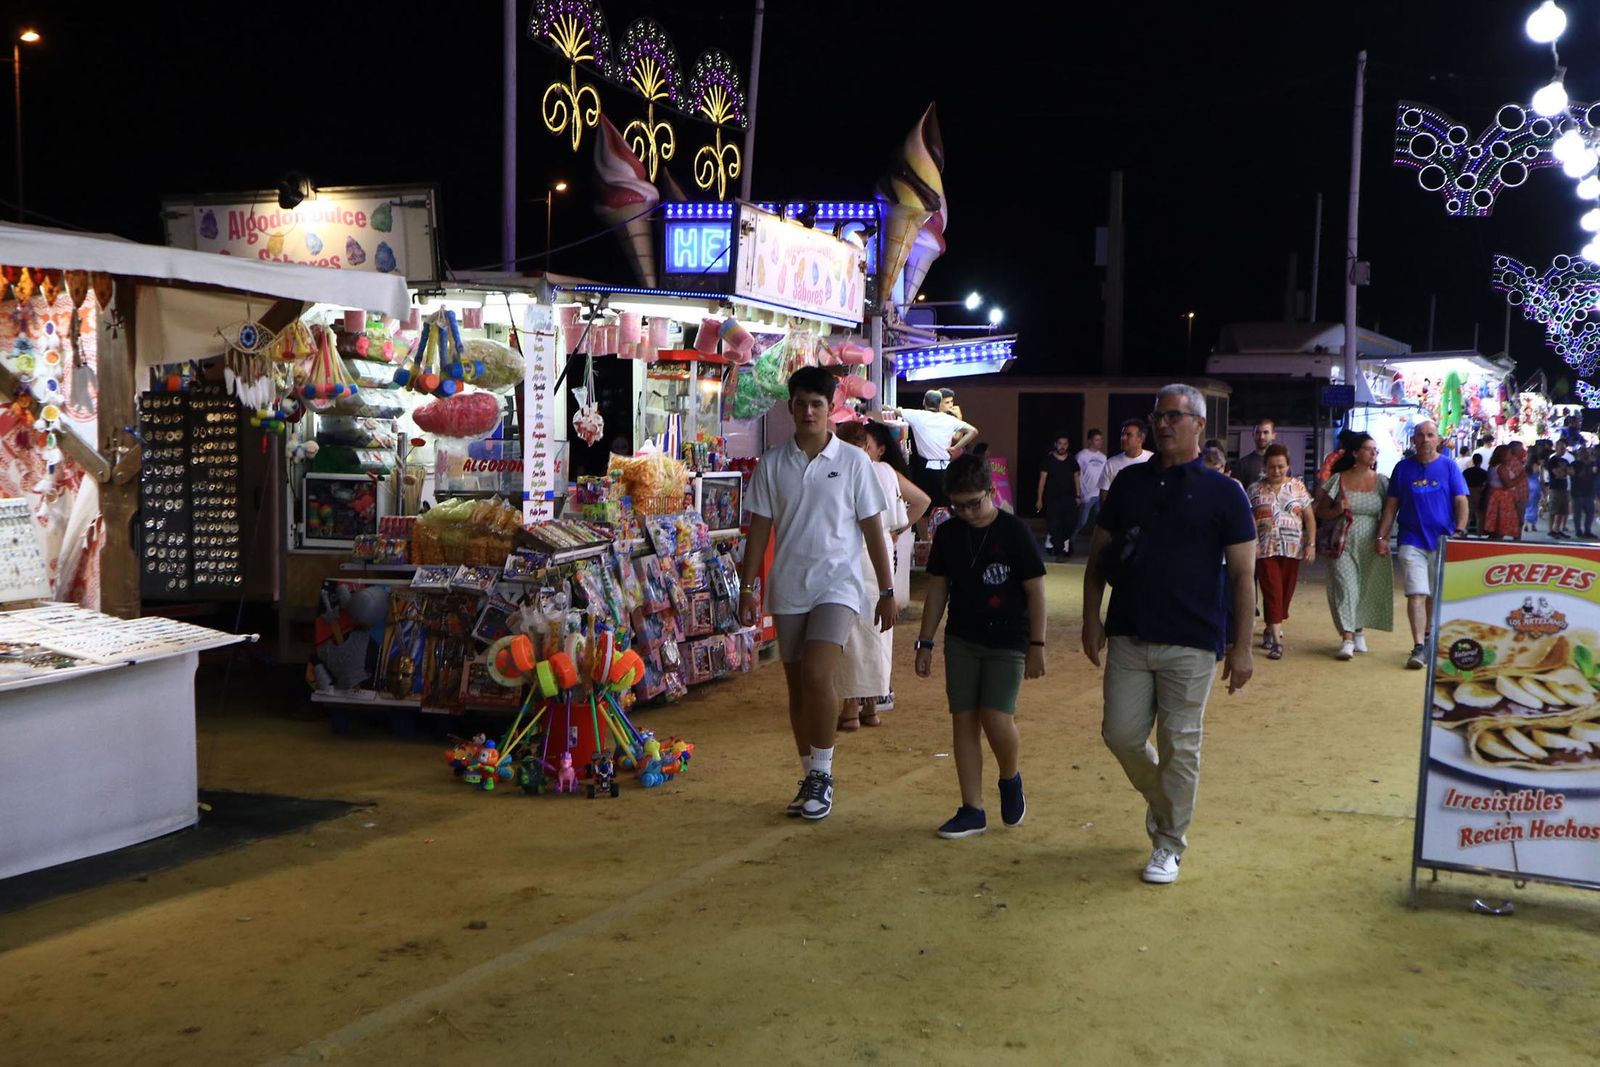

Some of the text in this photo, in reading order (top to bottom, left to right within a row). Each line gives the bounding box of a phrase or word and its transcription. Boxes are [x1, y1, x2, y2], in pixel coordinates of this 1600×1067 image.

[227, 208, 304, 245] Algodon
[792, 271, 824, 306] Sabores
[1484, 563, 1597, 590] CREPES
[1445, 788, 1564, 811] Irresistibles
[1529, 818, 1600, 840] Hechos
